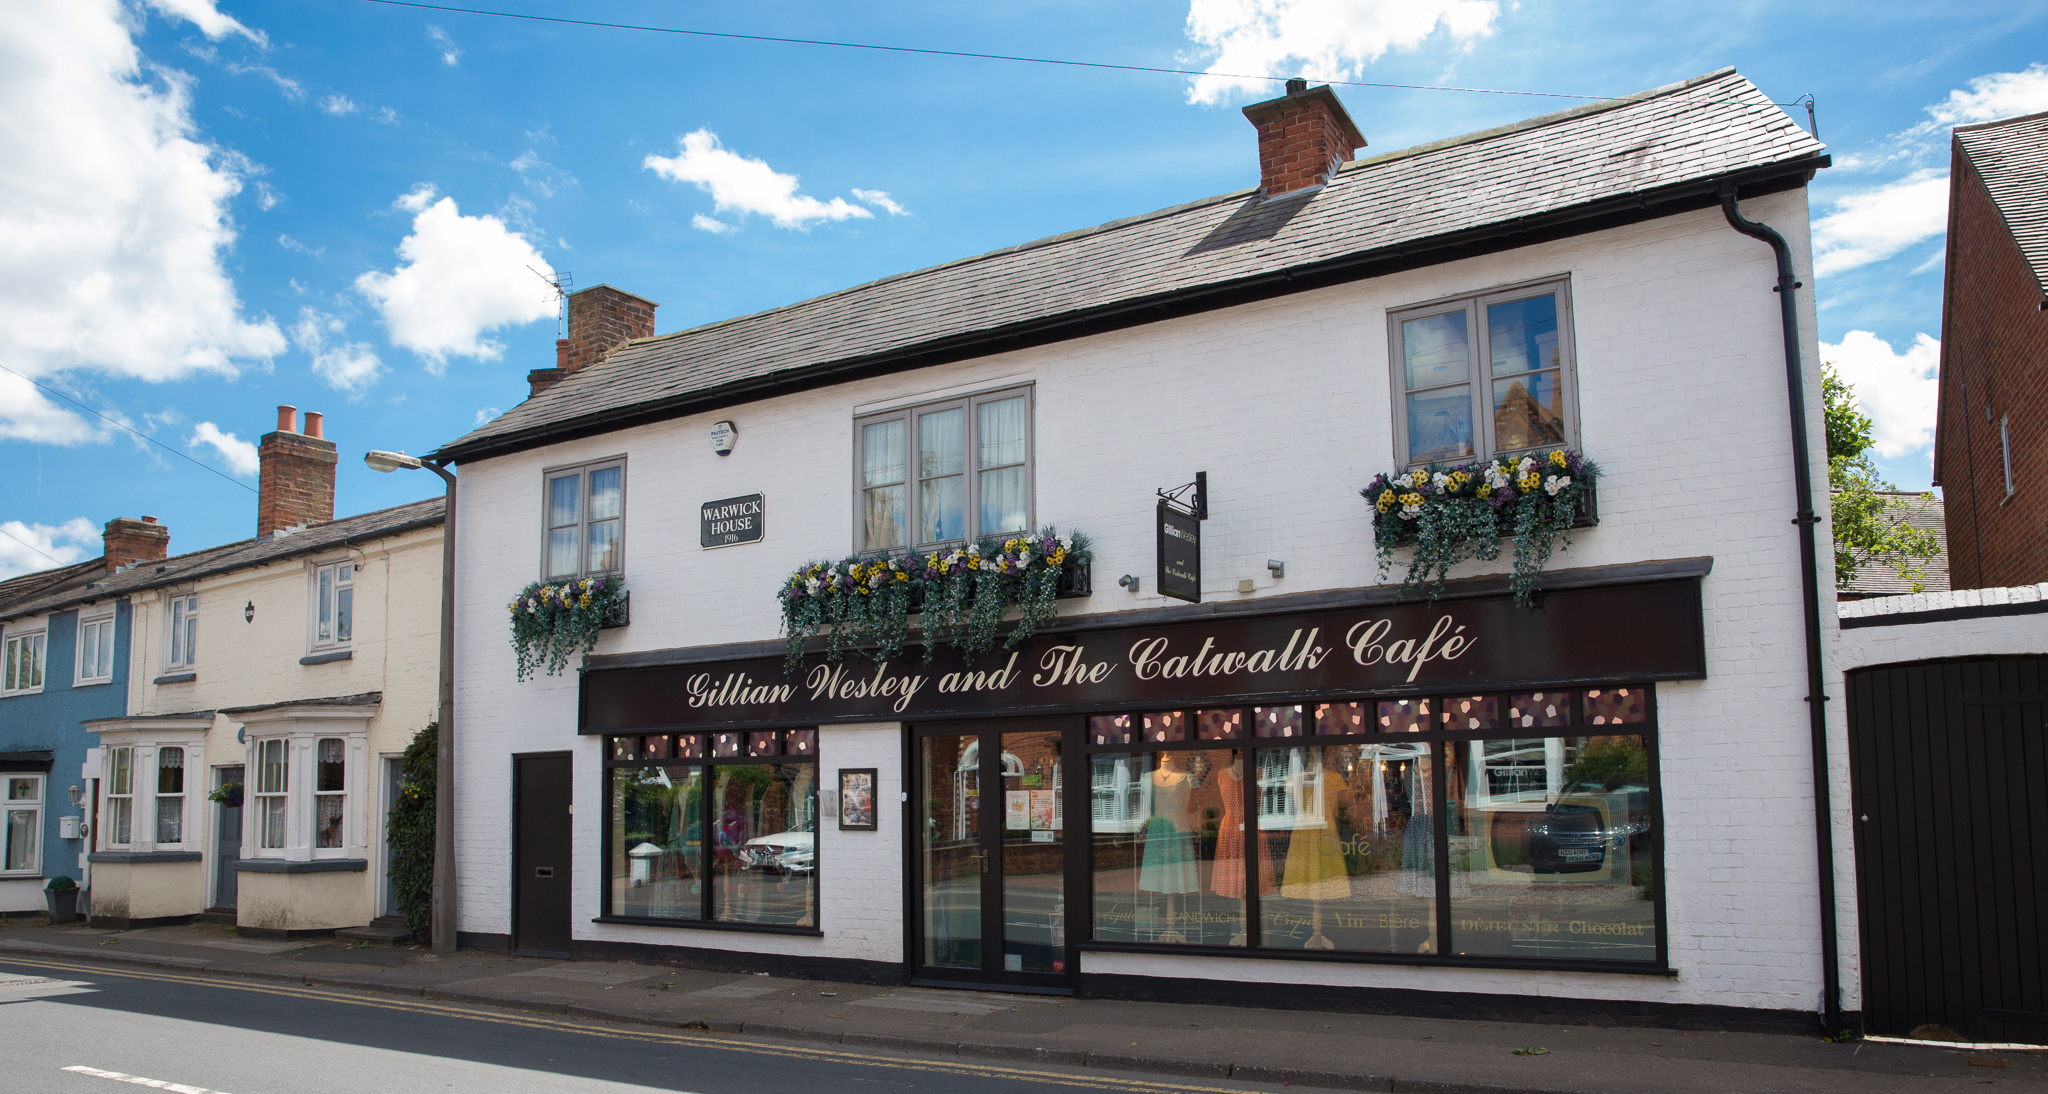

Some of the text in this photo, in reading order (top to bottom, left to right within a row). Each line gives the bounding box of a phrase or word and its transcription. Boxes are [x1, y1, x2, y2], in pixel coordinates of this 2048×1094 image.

[703, 500, 761, 521] WARWICK
[711, 516, 752, 535] HOUSE
[724, 533, 739, 543] 1916
[686, 614, 1478, 713] Gillian Wesley and The Catwalk Café
[1317, 834, 1371, 856] Café
[1172, 911, 1236, 925] SANDWICH
[1334, 911, 1363, 928] Vin
[1379, 914, 1420, 929] Bière
[1568, 920, 1645, 936] Chocolat
